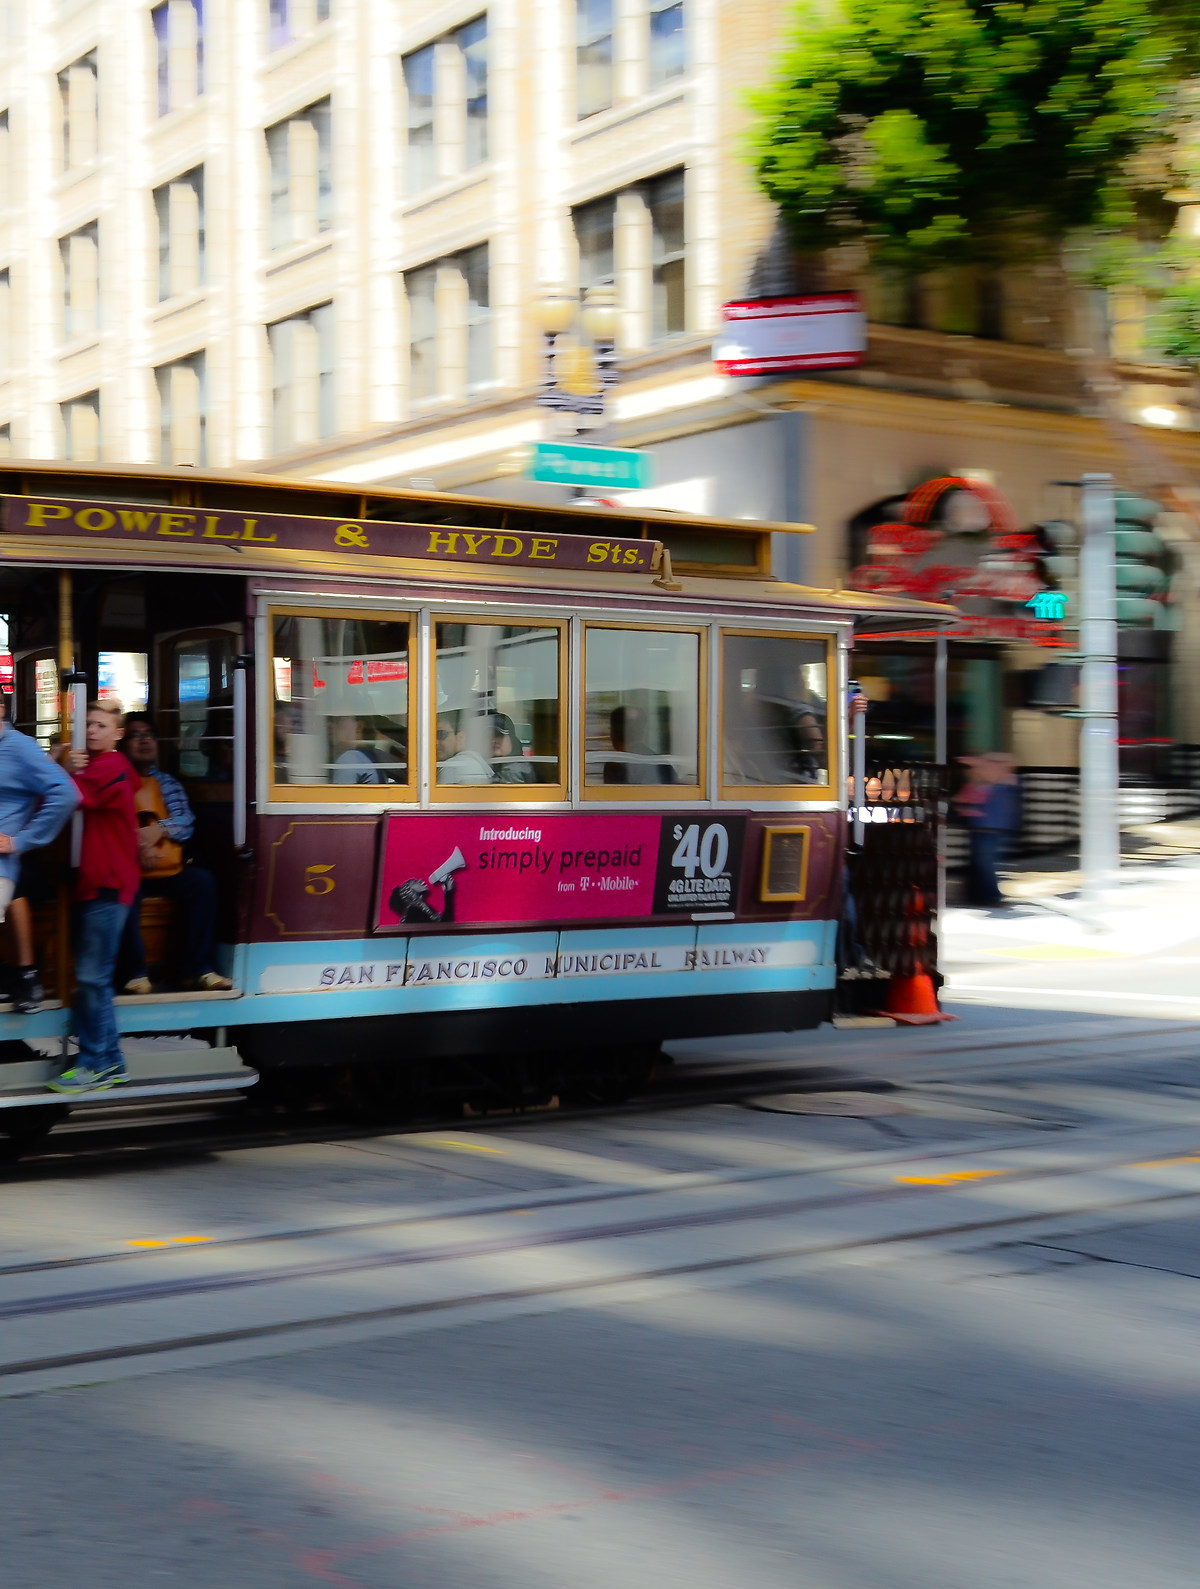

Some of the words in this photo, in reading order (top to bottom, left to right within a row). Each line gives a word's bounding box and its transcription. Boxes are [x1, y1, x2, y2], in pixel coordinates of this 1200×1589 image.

[24, 503, 278, 542] POWELL
[333, 523, 370, 548] &
[426, 531, 558, 560] HYDE
[586, 542, 645, 565] Sts.
[479, 827, 542, 843] Introducing
[672, 823, 729, 878] $40
[478, 845, 554, 874] simply
[560, 844, 642, 874] prepaid
[304, 863, 337, 895] 5
[557, 881, 575, 892] from
[320, 964, 376, 986] SAN
[385, 958, 529, 984] FRANCISCO
[544, 951, 663, 975] MUNICIPAL
[684, 947, 772, 968] RAILWAY
